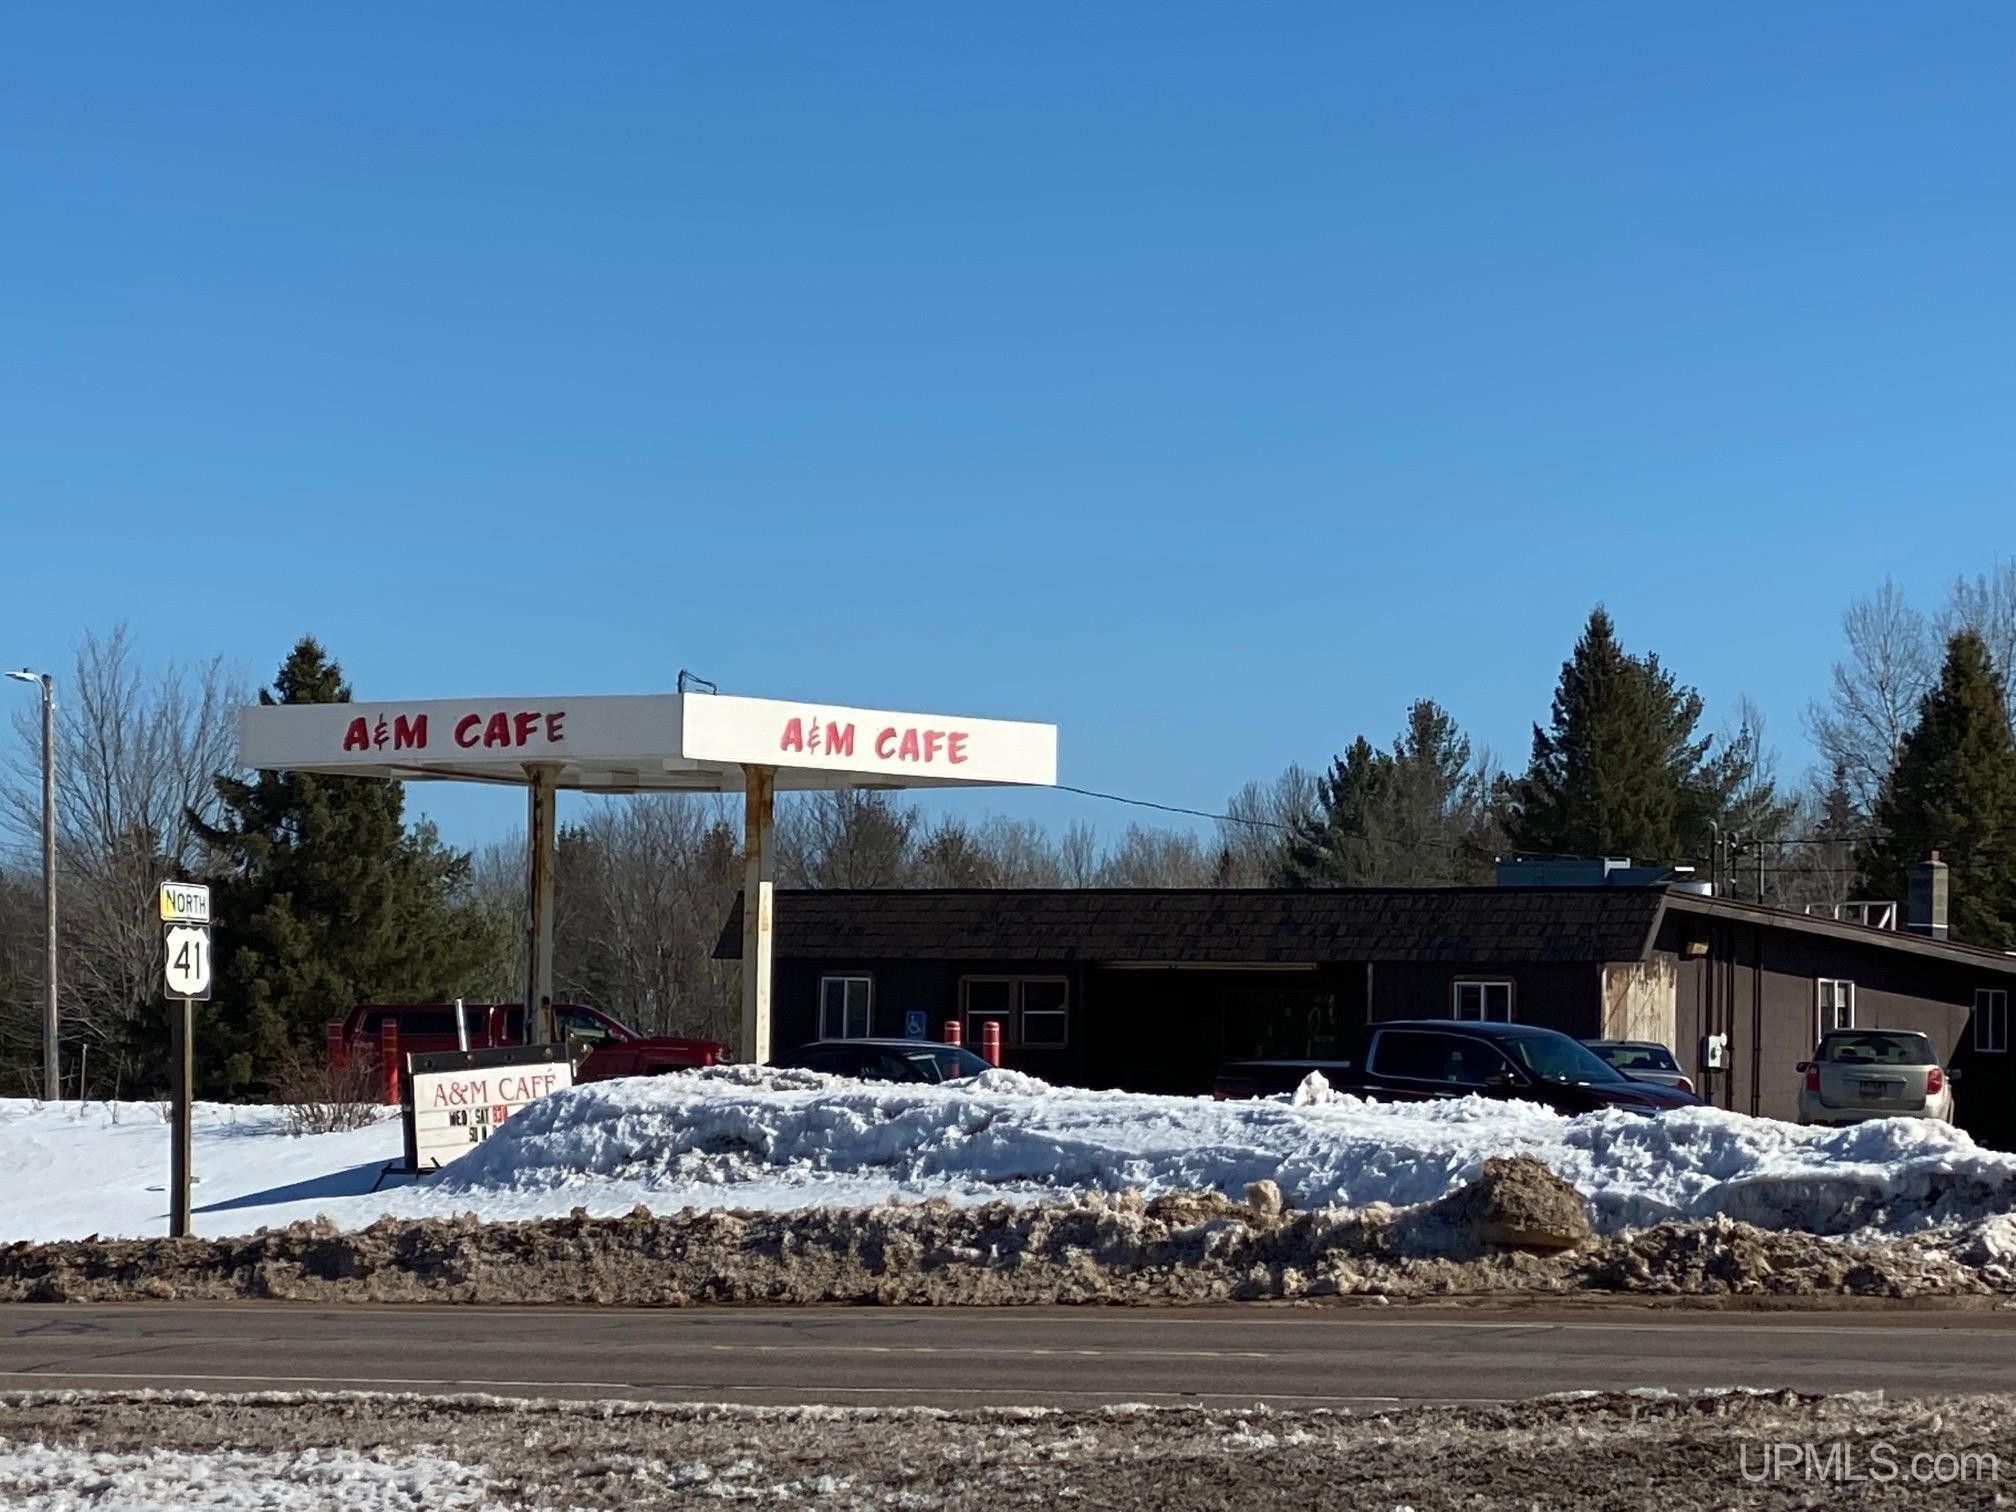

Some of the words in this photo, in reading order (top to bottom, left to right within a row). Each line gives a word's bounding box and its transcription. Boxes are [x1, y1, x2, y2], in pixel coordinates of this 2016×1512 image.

[343, 712, 428, 751] A&M
[454, 711, 566, 749] CAFE
[780, 716, 856, 757] A&M
[875, 726, 969, 765] CAFE
[166, 889, 207, 915] NORTH
[173, 941, 200, 980] 41
[434, 1079, 489, 1107] A&M
